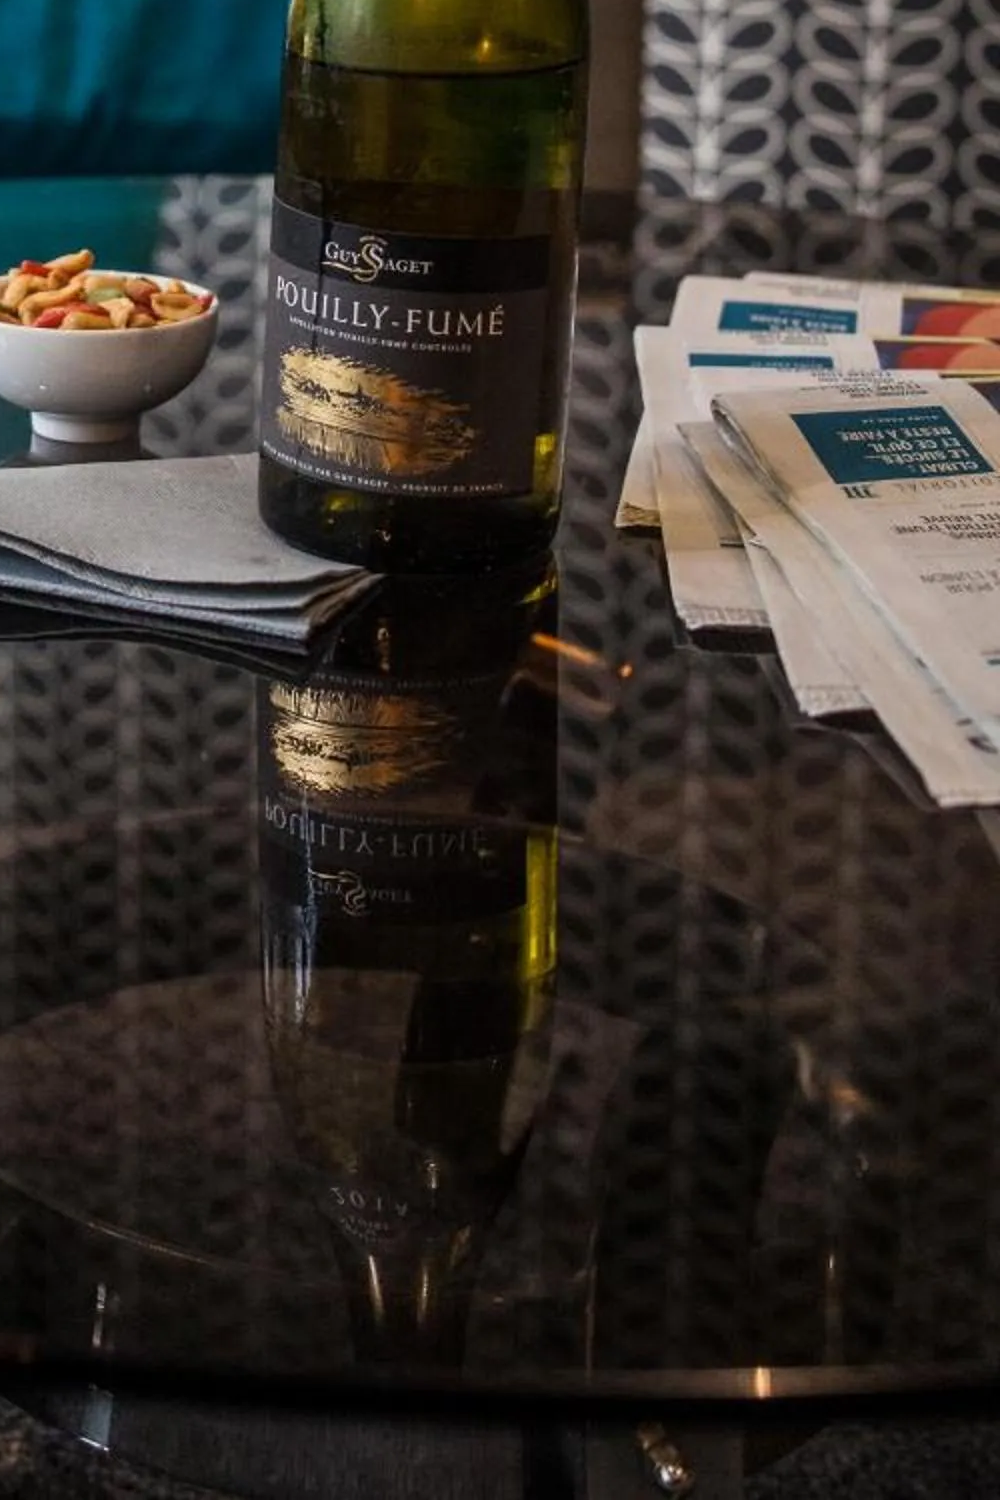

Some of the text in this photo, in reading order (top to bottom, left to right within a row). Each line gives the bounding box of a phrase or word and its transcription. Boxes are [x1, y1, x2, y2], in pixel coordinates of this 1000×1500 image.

[276, 275, 506, 337] POUILLY-FUMÉ
[948, 448, 971, 459] LE
[919, 460, 979, 473] CLIMAT
